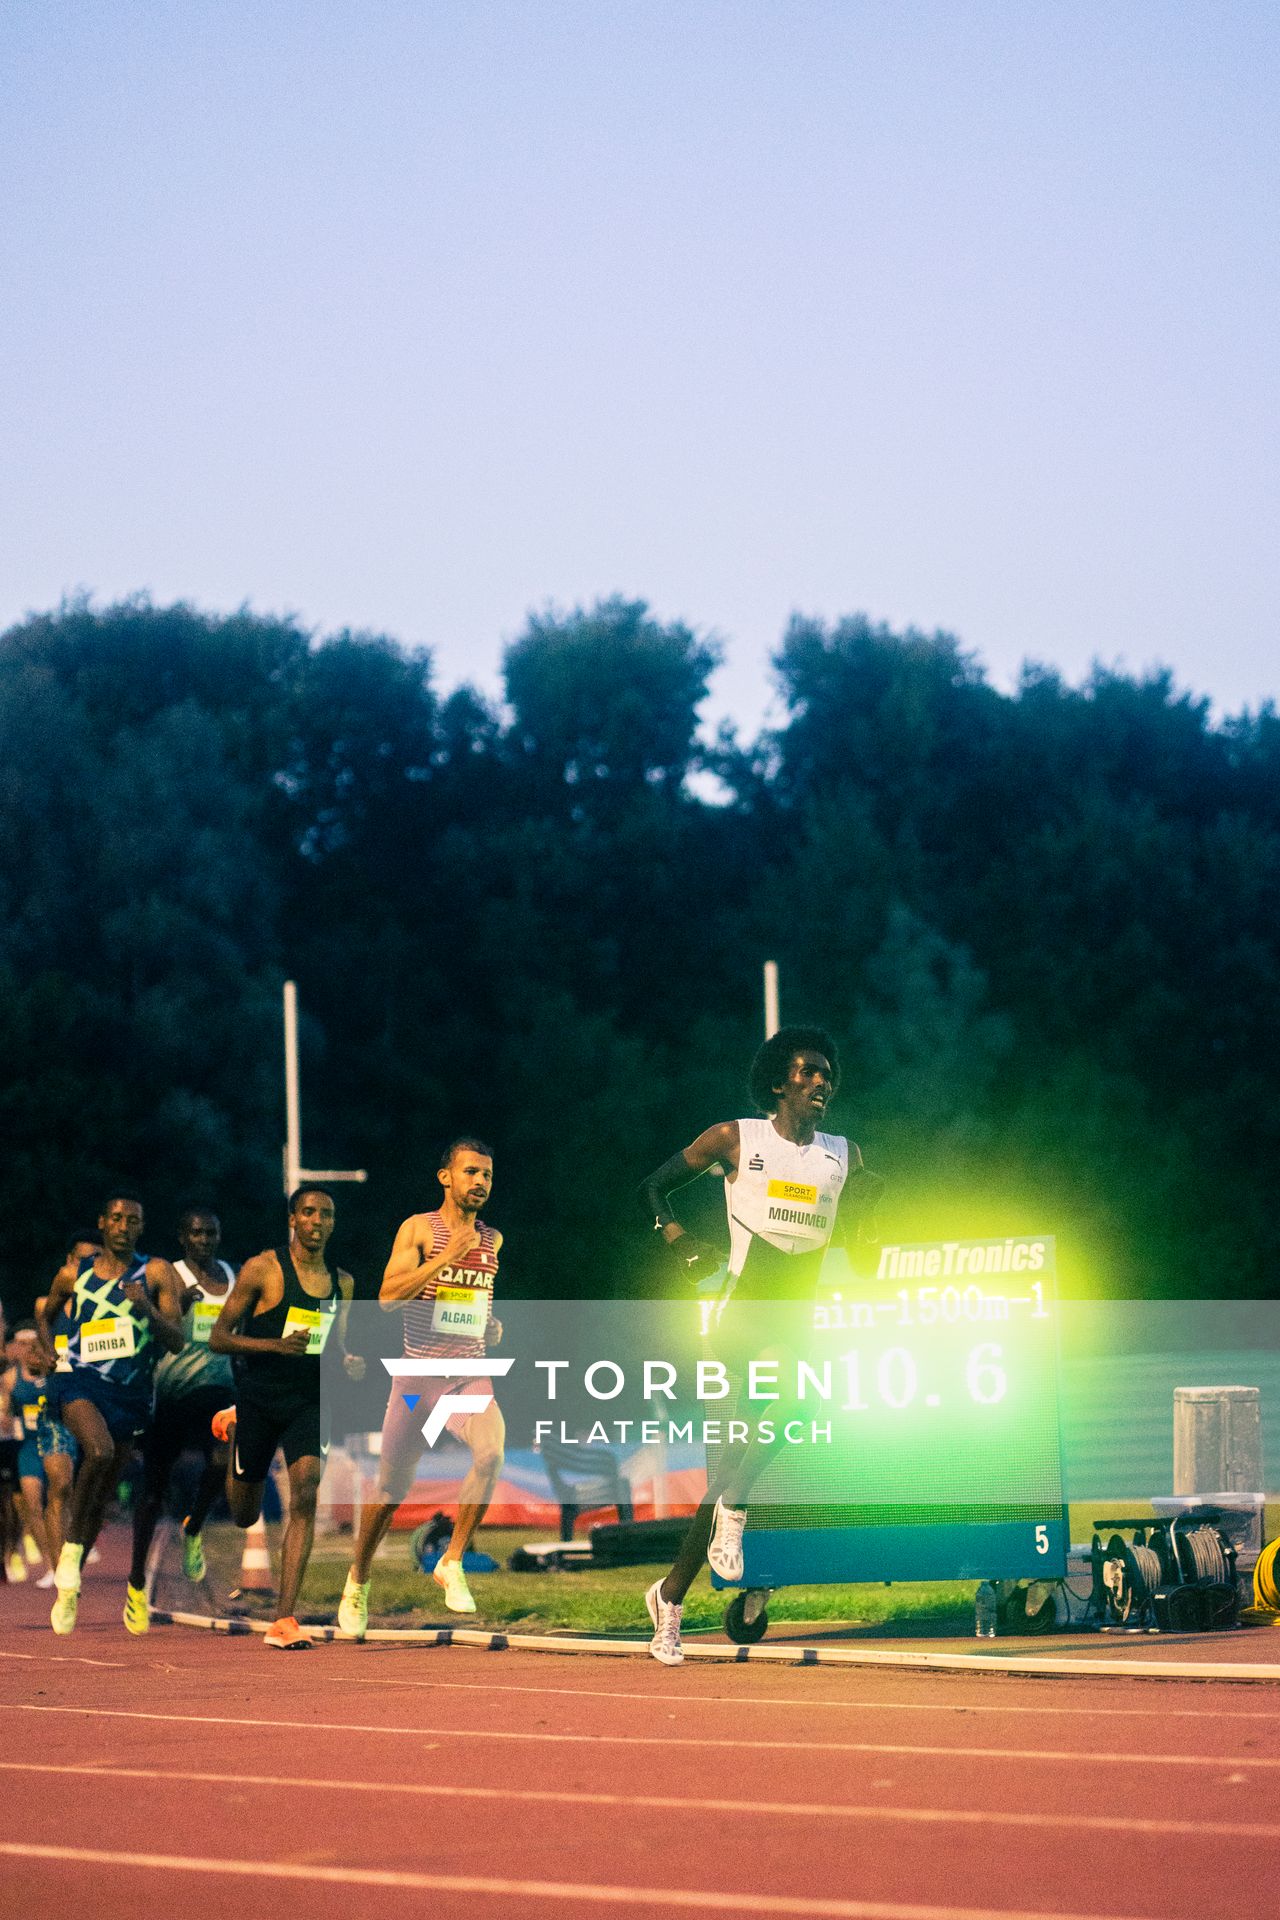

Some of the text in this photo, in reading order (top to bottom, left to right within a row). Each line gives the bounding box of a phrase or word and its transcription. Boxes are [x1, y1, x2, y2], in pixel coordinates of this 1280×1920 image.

[784, 1185, 811, 1196] SPORT
[768, 1206, 828, 1229] MOHUMED
[876, 1240, 1046, 1280] TimeTronics
[438, 1266, 494, 1290] QATAR
[87, 1337, 127, 1353] DIRIBA
[1035, 1525, 1049, 1554] 5
